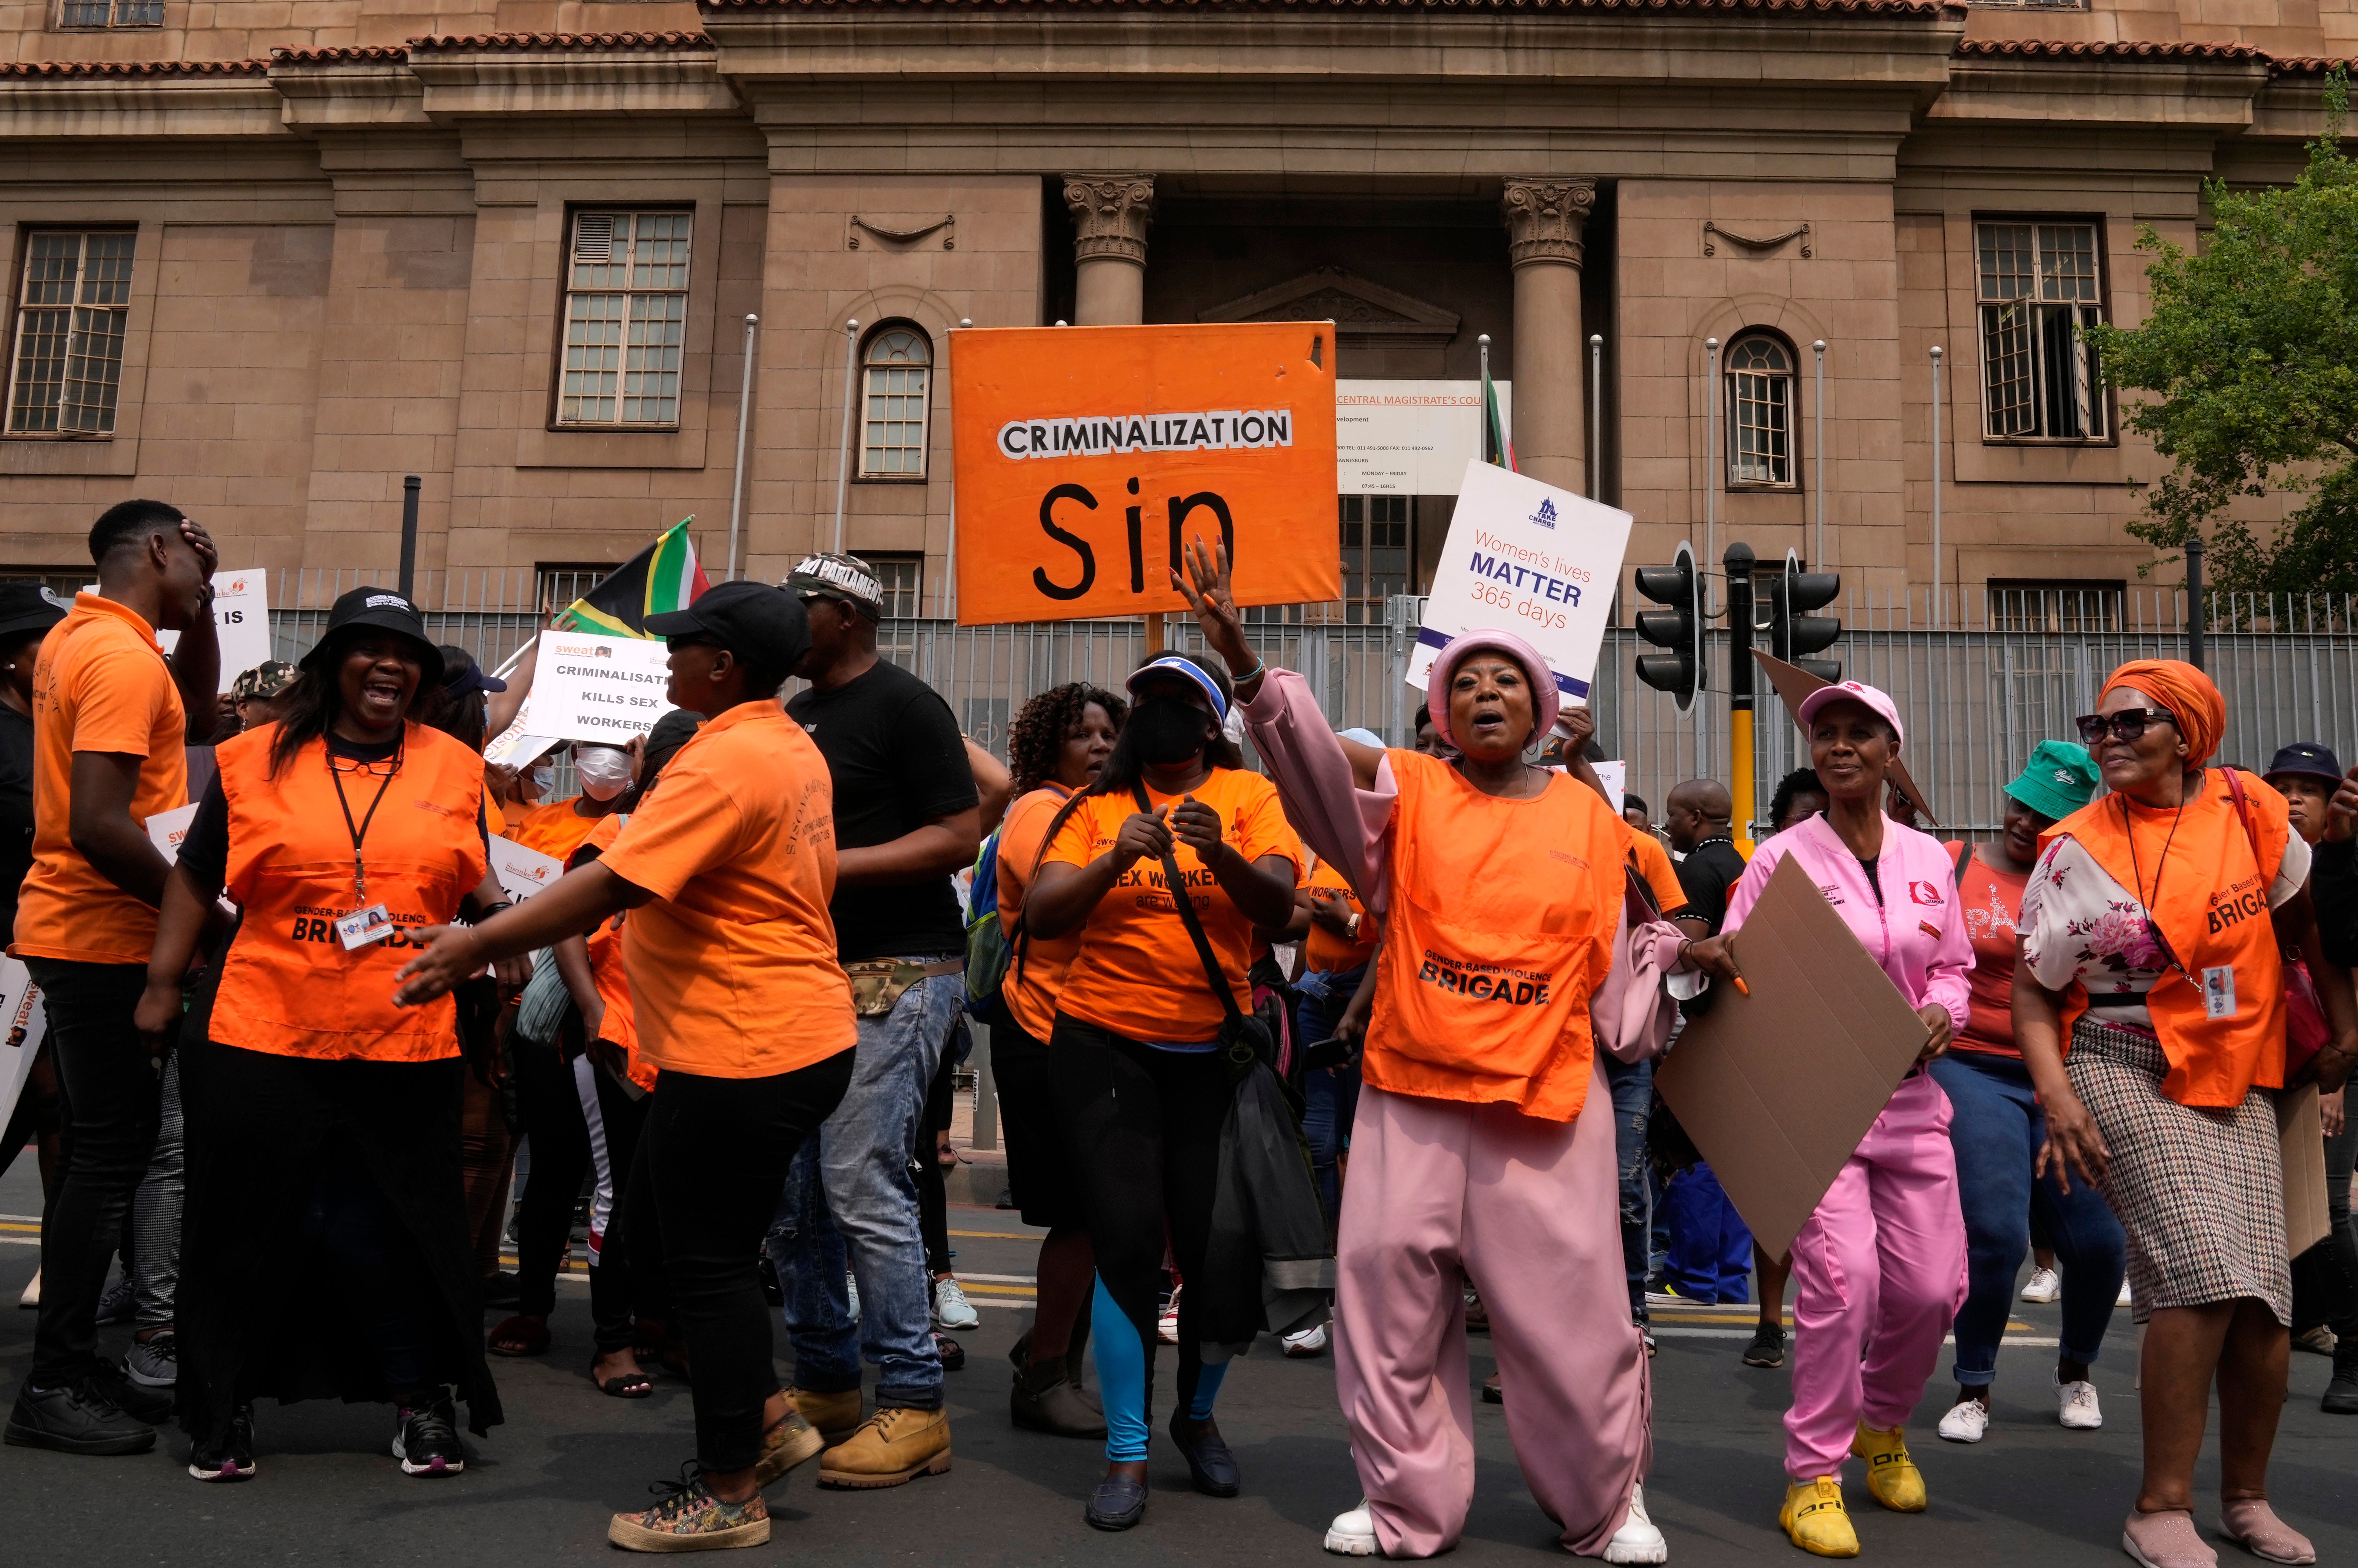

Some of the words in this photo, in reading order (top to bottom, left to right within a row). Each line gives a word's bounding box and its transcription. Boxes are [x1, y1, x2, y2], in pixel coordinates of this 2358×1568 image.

[1337, 396, 1381, 404] CENTRAL
[1384, 396, 1456, 404] MAGISTRATE'S
[1003, 416, 1288, 453] CRIMINALIZATION
[1529, 515, 1556, 528] CHARGE
[1537, 512, 1556, 522] TAKE
[1033, 476, 1234, 600] Sin
[1476, 529, 1549, 568] Women's
[1554, 557, 1591, 582] lives
[1469, 551, 1581, 608] MATTER
[1471, 582, 1512, 609] 365
[1518, 598, 1566, 628] days
[225, 611, 243, 624] IS
[555, 645, 594, 655] sweat
[581, 692, 624, 704] KILLS
[629, 697, 659, 709] SEX
[577, 715, 656, 732] WORKERS
[505, 862, 531, 878] Sisonke
[2230, 876, 2254, 892] Based
[1136, 895, 1158, 907] are
[390, 913, 426, 924] OLENCE
[2207, 887, 2268, 935] BRIGA
[1425, 949, 1500, 975] GENDER-BASED
[1503, 967, 1552, 982] VIOLENCE
[1418, 960, 1550, 1006] BRIGADE
